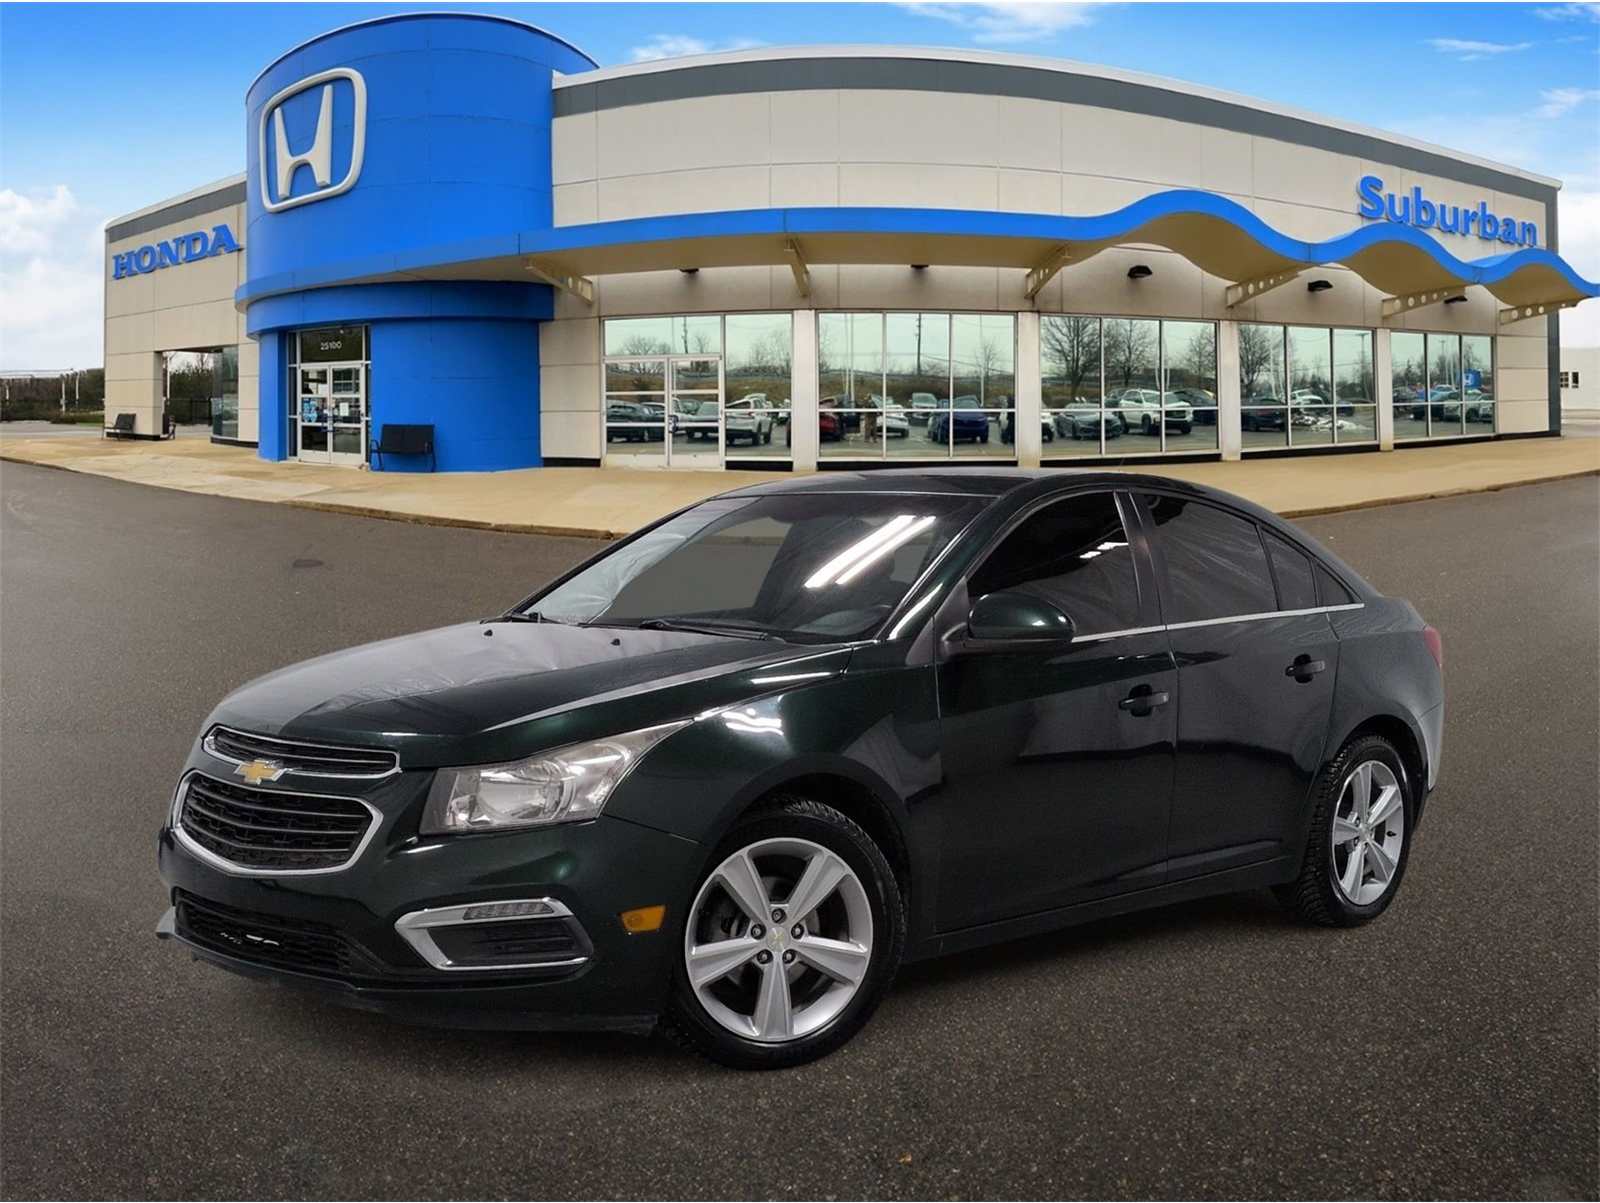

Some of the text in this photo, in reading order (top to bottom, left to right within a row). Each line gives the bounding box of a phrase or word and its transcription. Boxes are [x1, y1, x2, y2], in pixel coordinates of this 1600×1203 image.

[1358, 175, 1537, 247] Suburban
[112, 224, 240, 280] HONDA
[320, 340, 342, 350] 25100
